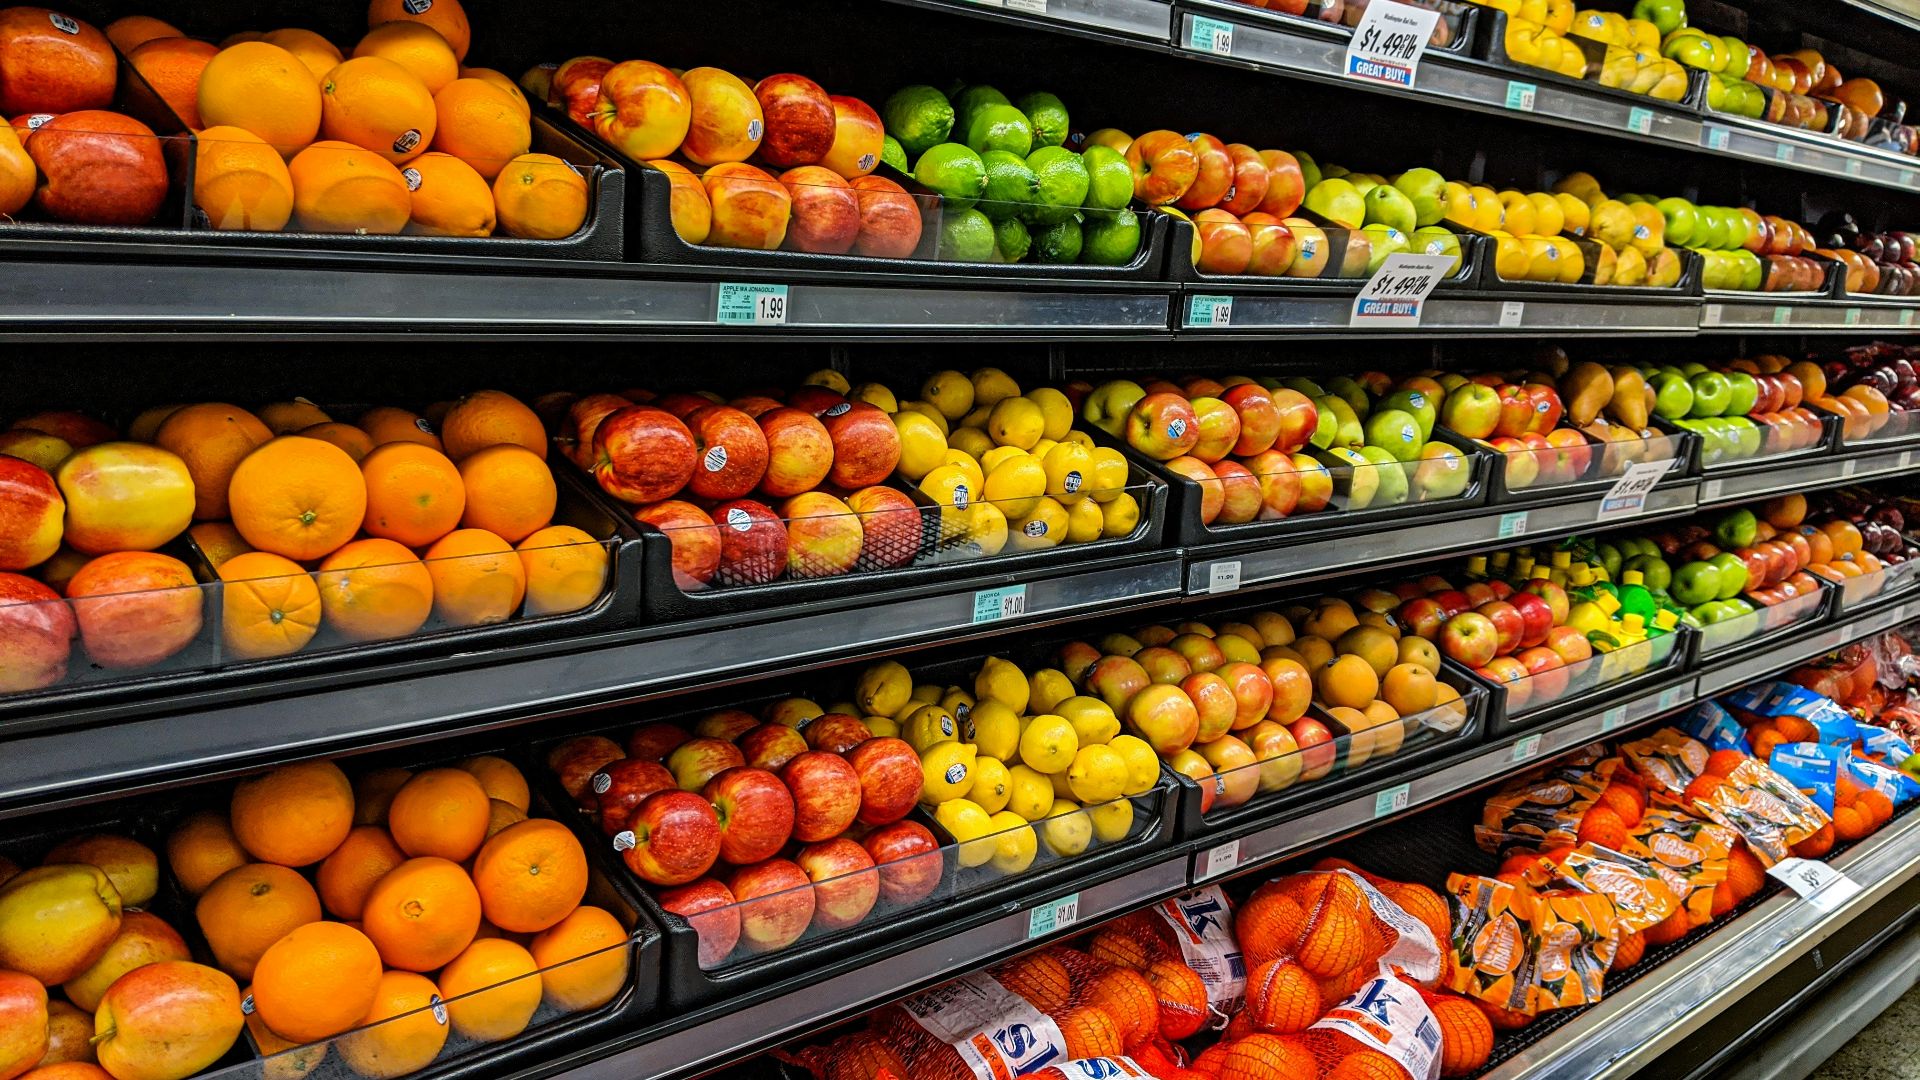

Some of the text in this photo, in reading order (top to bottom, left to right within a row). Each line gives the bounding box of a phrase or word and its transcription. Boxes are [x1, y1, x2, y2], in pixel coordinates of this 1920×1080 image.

[1216, 33, 1230, 52] 1.99
[1360, 24, 1403, 56] $1.49
[1356, 61, 1384, 78] GREAT
[1385, 66, 1406, 82] BUY!
[1371, 274, 1415, 295] $1.49
[761, 296, 783, 318] 1.99
[1216, 306, 1229, 322] 1.99
[1364, 302, 1412, 314] GREAT BUY!
